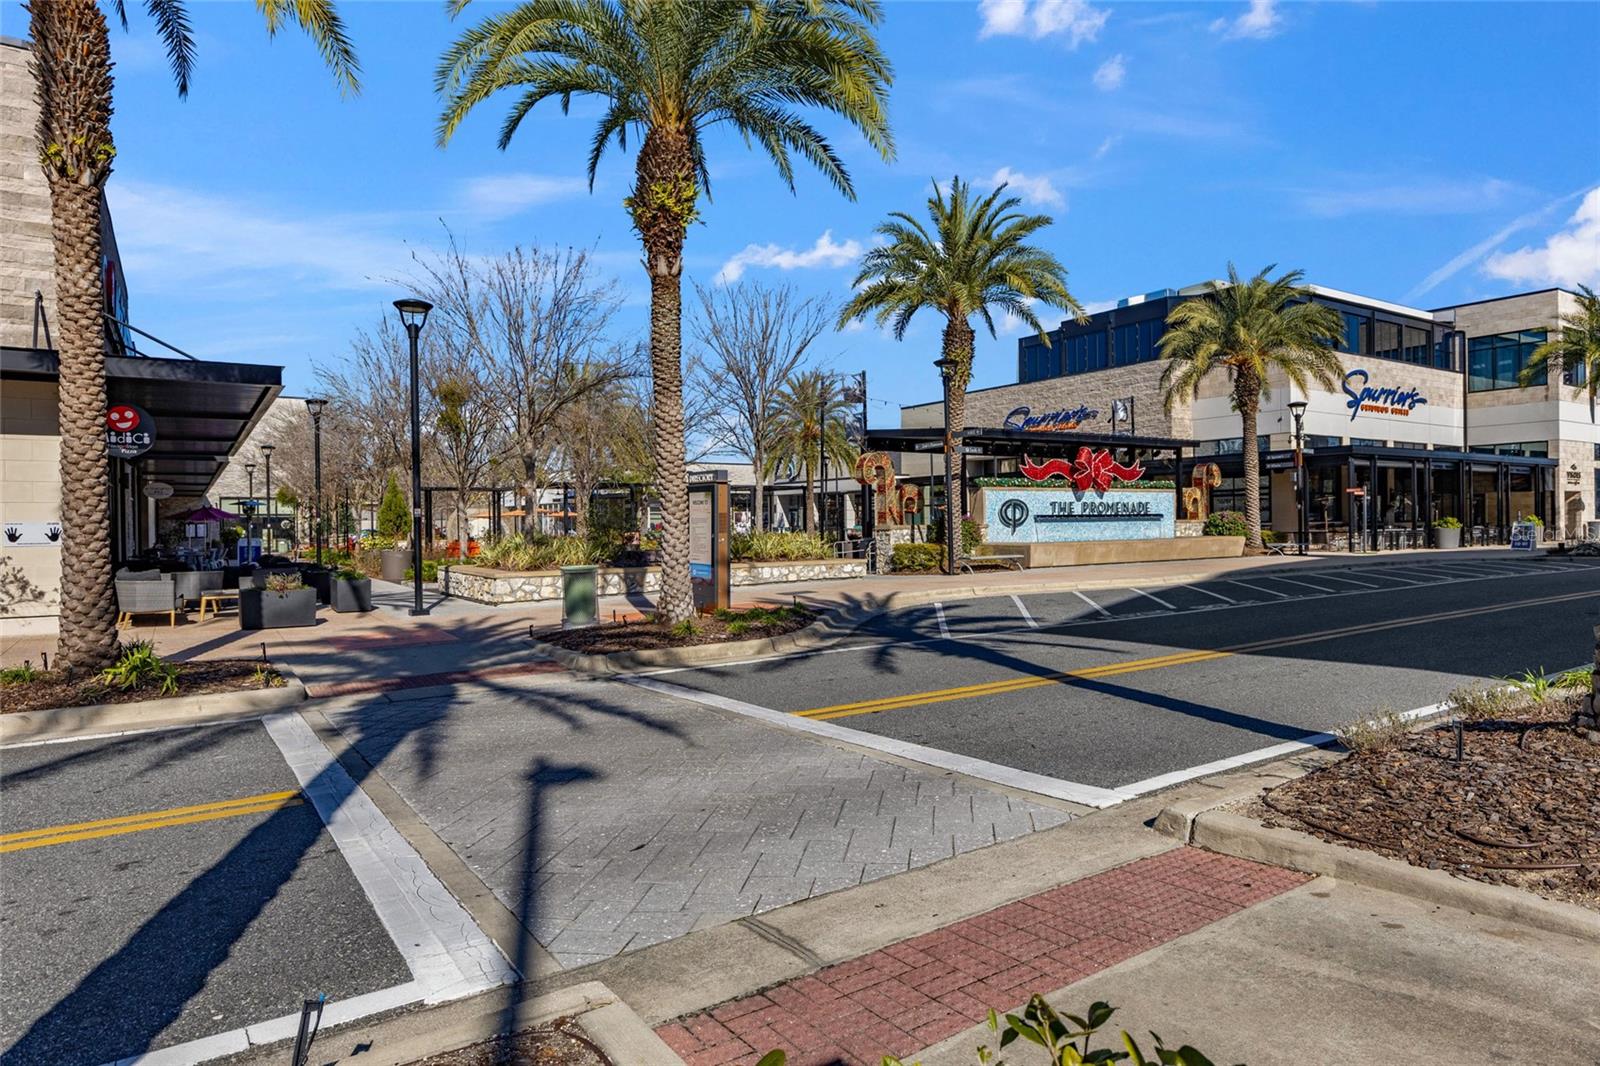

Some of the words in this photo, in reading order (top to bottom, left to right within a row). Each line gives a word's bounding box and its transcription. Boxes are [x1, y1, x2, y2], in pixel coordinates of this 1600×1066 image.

[1341, 369, 1428, 422] Spurrier's
[106, 431, 150, 445] idiCi
[1049, 501, 1075, 514] THE
[1081, 501, 1151, 515] PROMENADE
